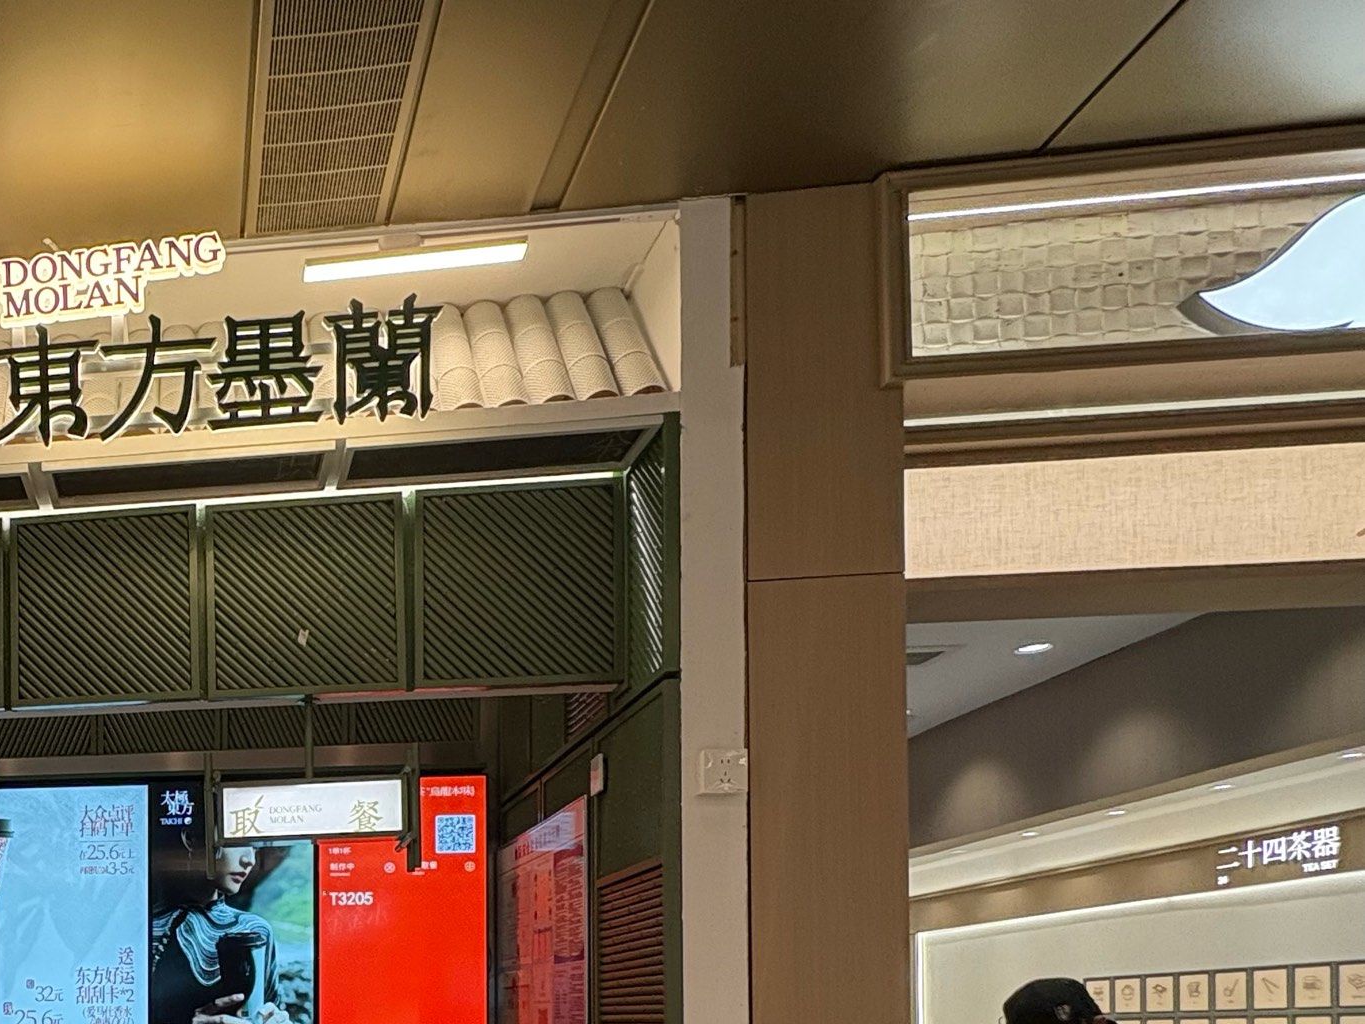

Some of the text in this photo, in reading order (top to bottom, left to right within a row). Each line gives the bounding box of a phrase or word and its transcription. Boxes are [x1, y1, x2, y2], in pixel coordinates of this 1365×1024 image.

[1, 234, 223, 288] DONGFANG
[3, 275, 142, 319] MOLAN
[229, 796, 264, 836] 取
[269, 804, 323, 815] DONGFANG
[347, 799, 383, 832] 餐
[269, 815, 304, 824] MOLAN
[1216, 826, 1341, 869] 二十四茶器
[329, 891, 374, 906] T3205
[118, 946, 134, 965] 送
[75, 966, 135, 985] 东方好运
[35, 985, 64, 1002] 32元
